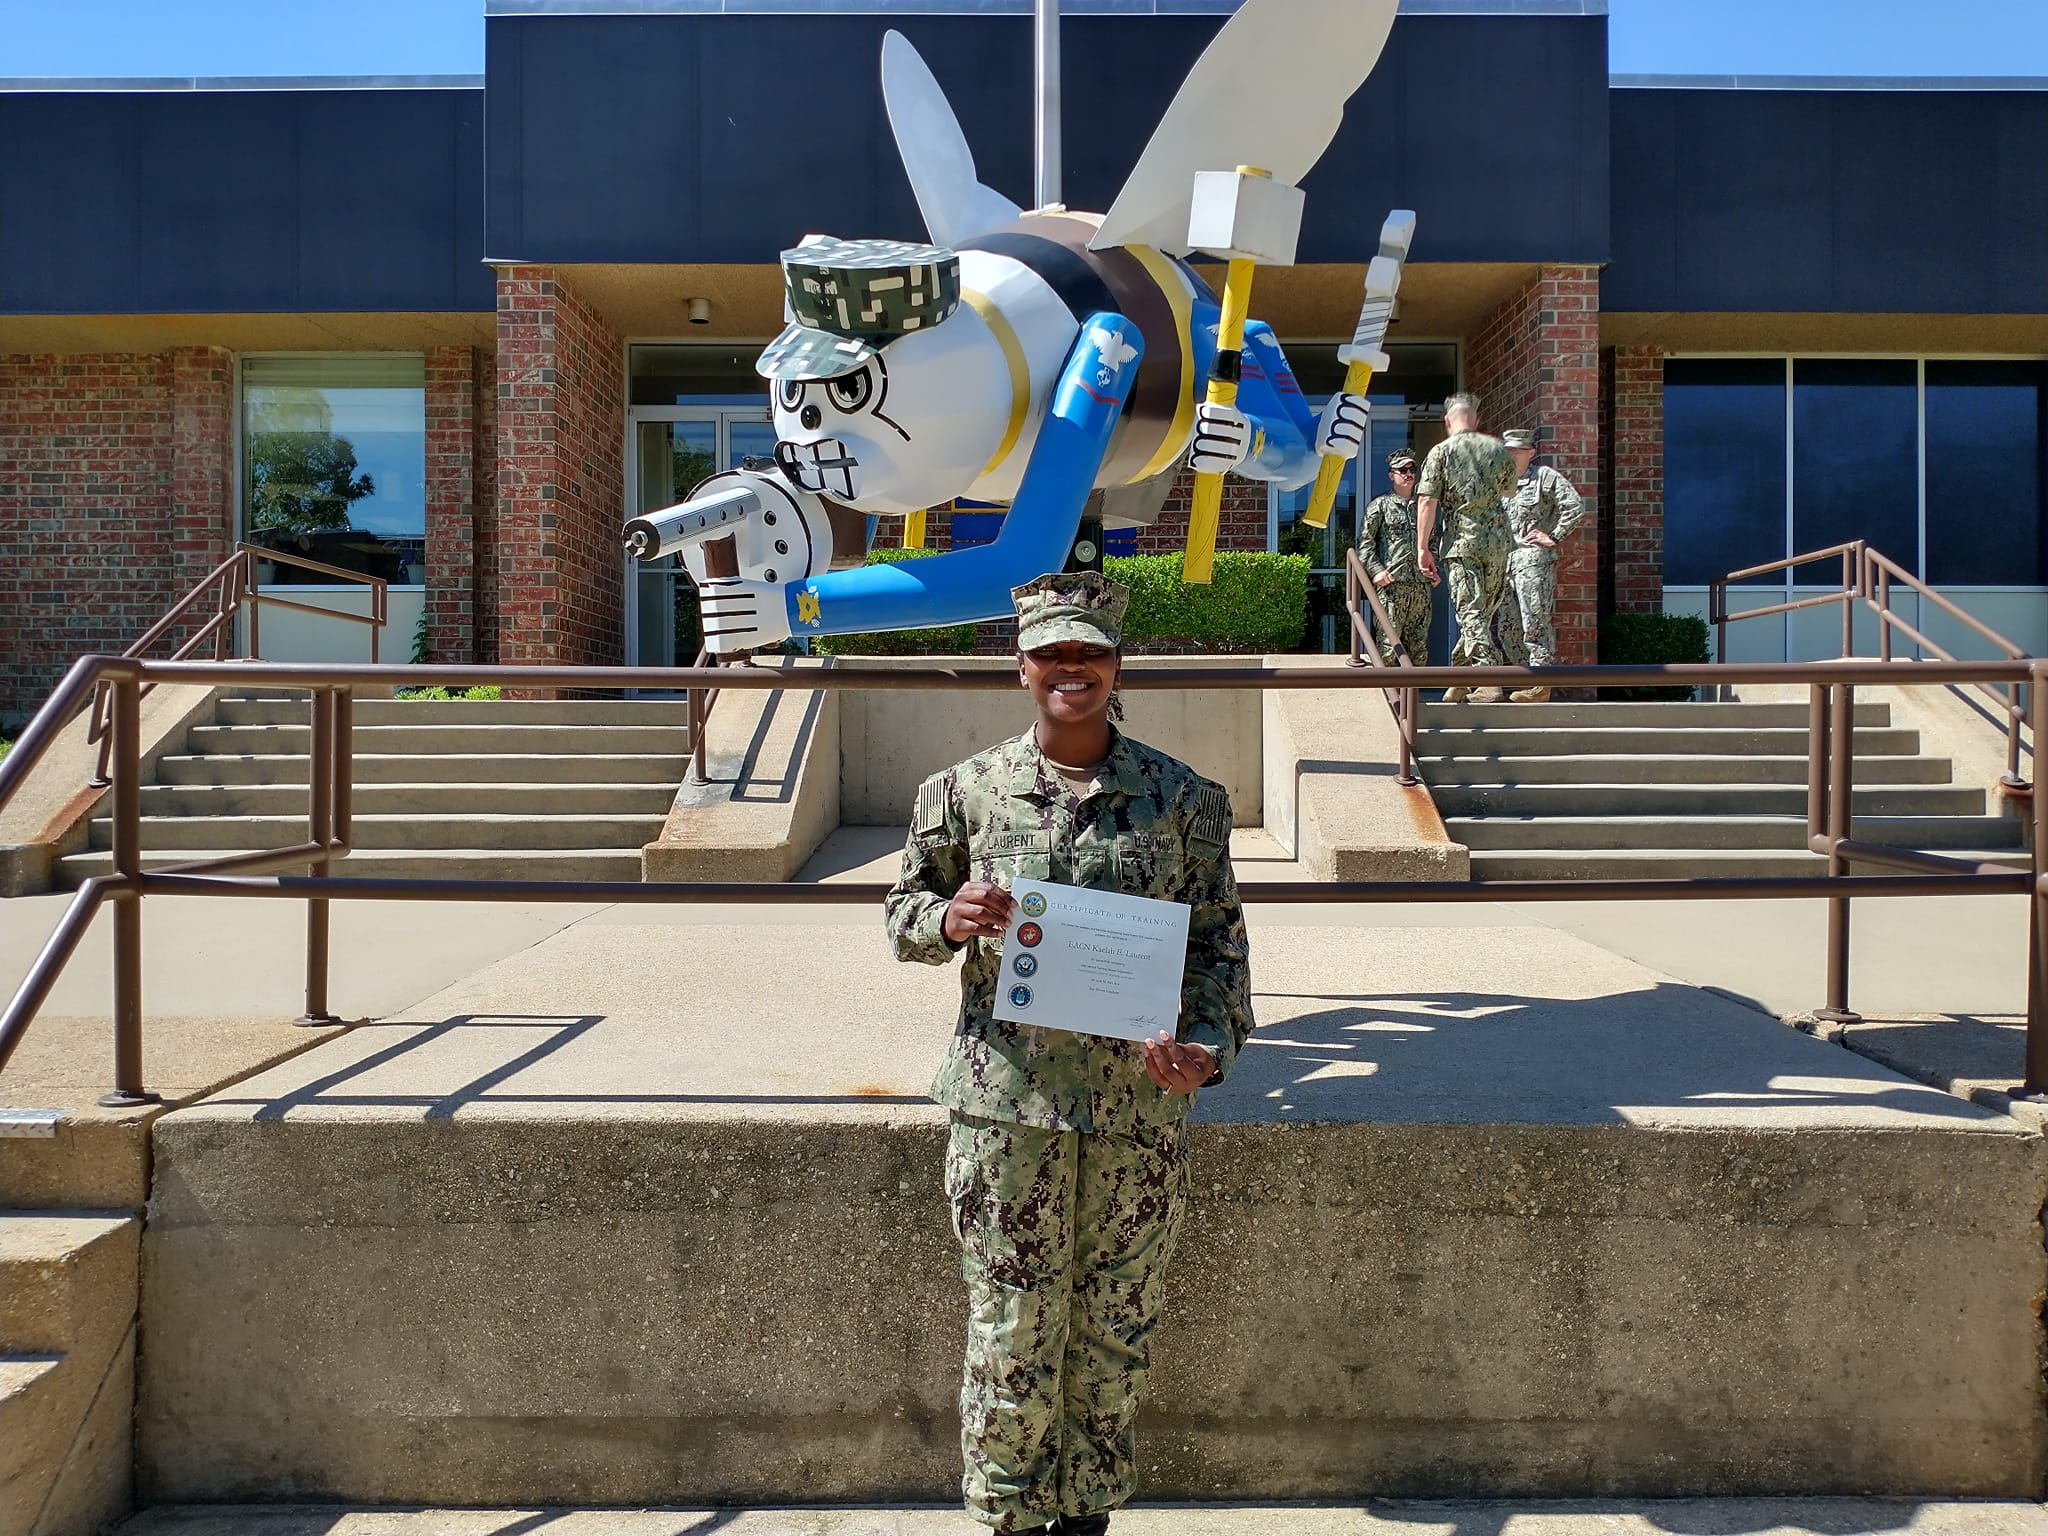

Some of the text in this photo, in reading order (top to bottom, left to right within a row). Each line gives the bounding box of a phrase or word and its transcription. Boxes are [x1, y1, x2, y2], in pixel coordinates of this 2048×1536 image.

[987, 834, 1036, 849] LAURENT
[1153, 837, 1175, 851] NAVY
[1050, 902, 1178, 928] CERTIFICATE OF TRAINING
